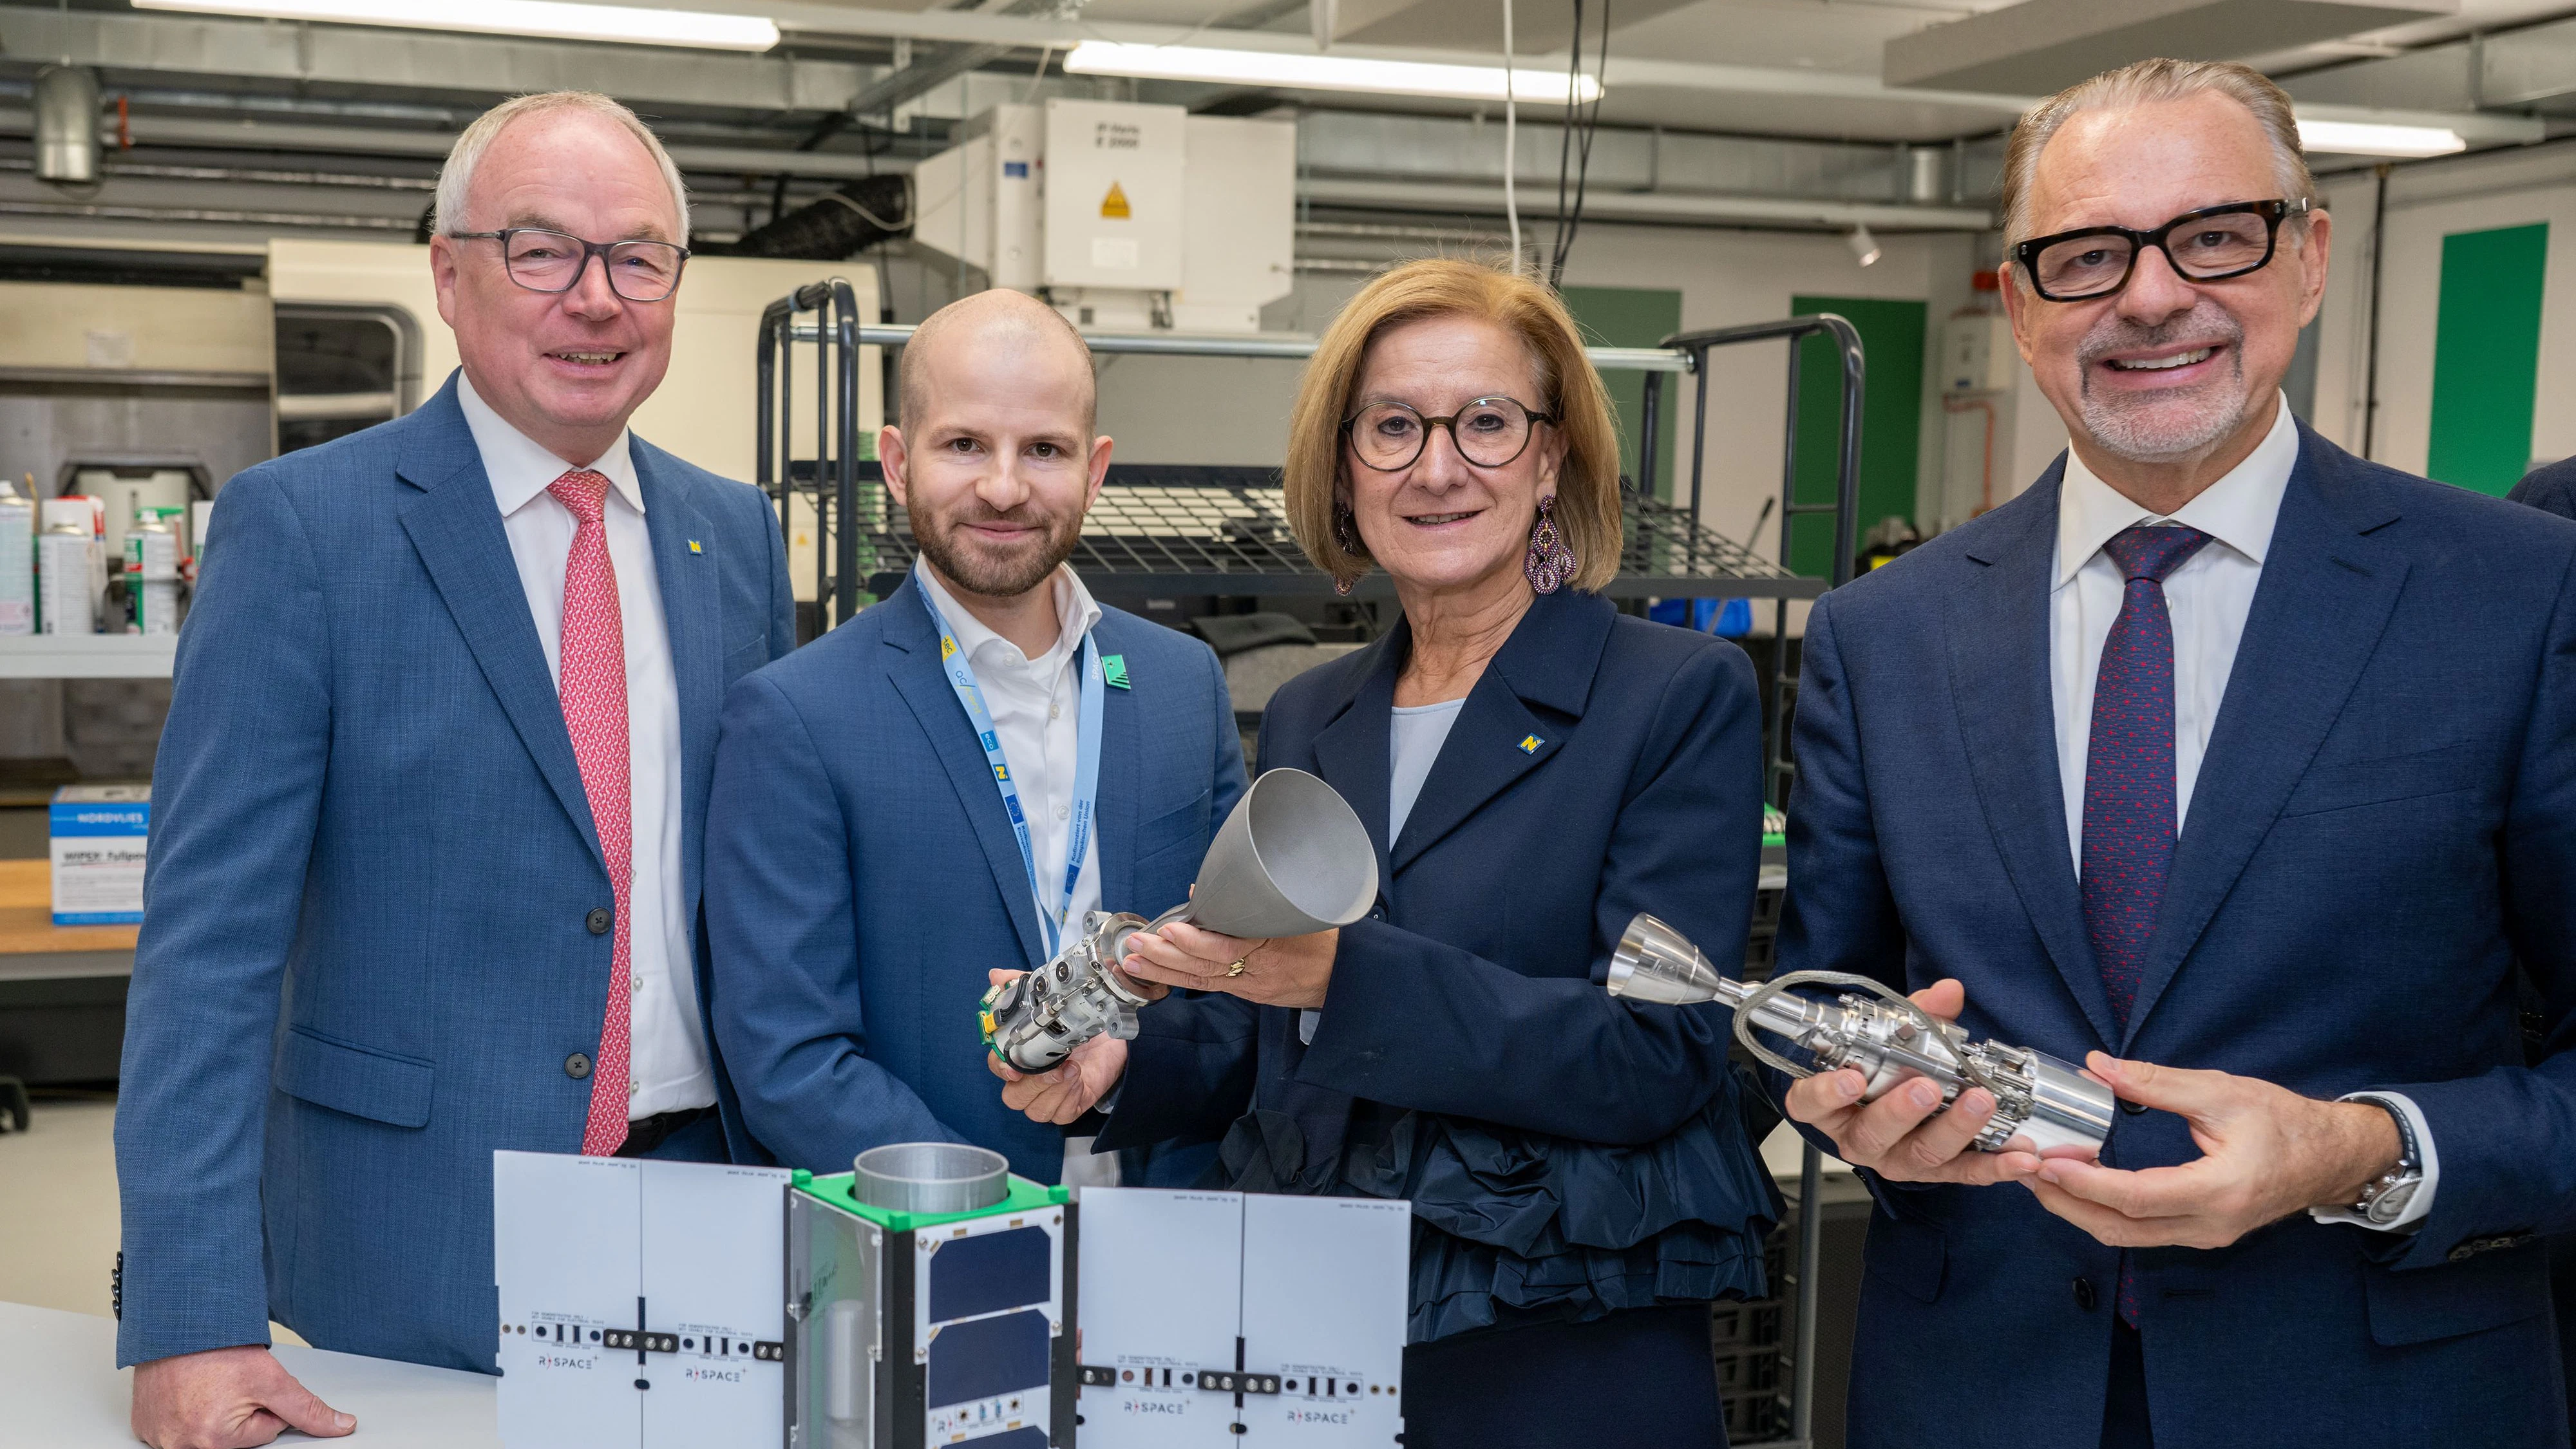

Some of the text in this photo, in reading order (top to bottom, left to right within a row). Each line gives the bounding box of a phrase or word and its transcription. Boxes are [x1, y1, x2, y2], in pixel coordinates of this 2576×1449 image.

[985, 734, 994, 750] eco
[1072, 824, 1081, 862] Kofinanziert
[1076, 821, 1088, 864] Europäischen
